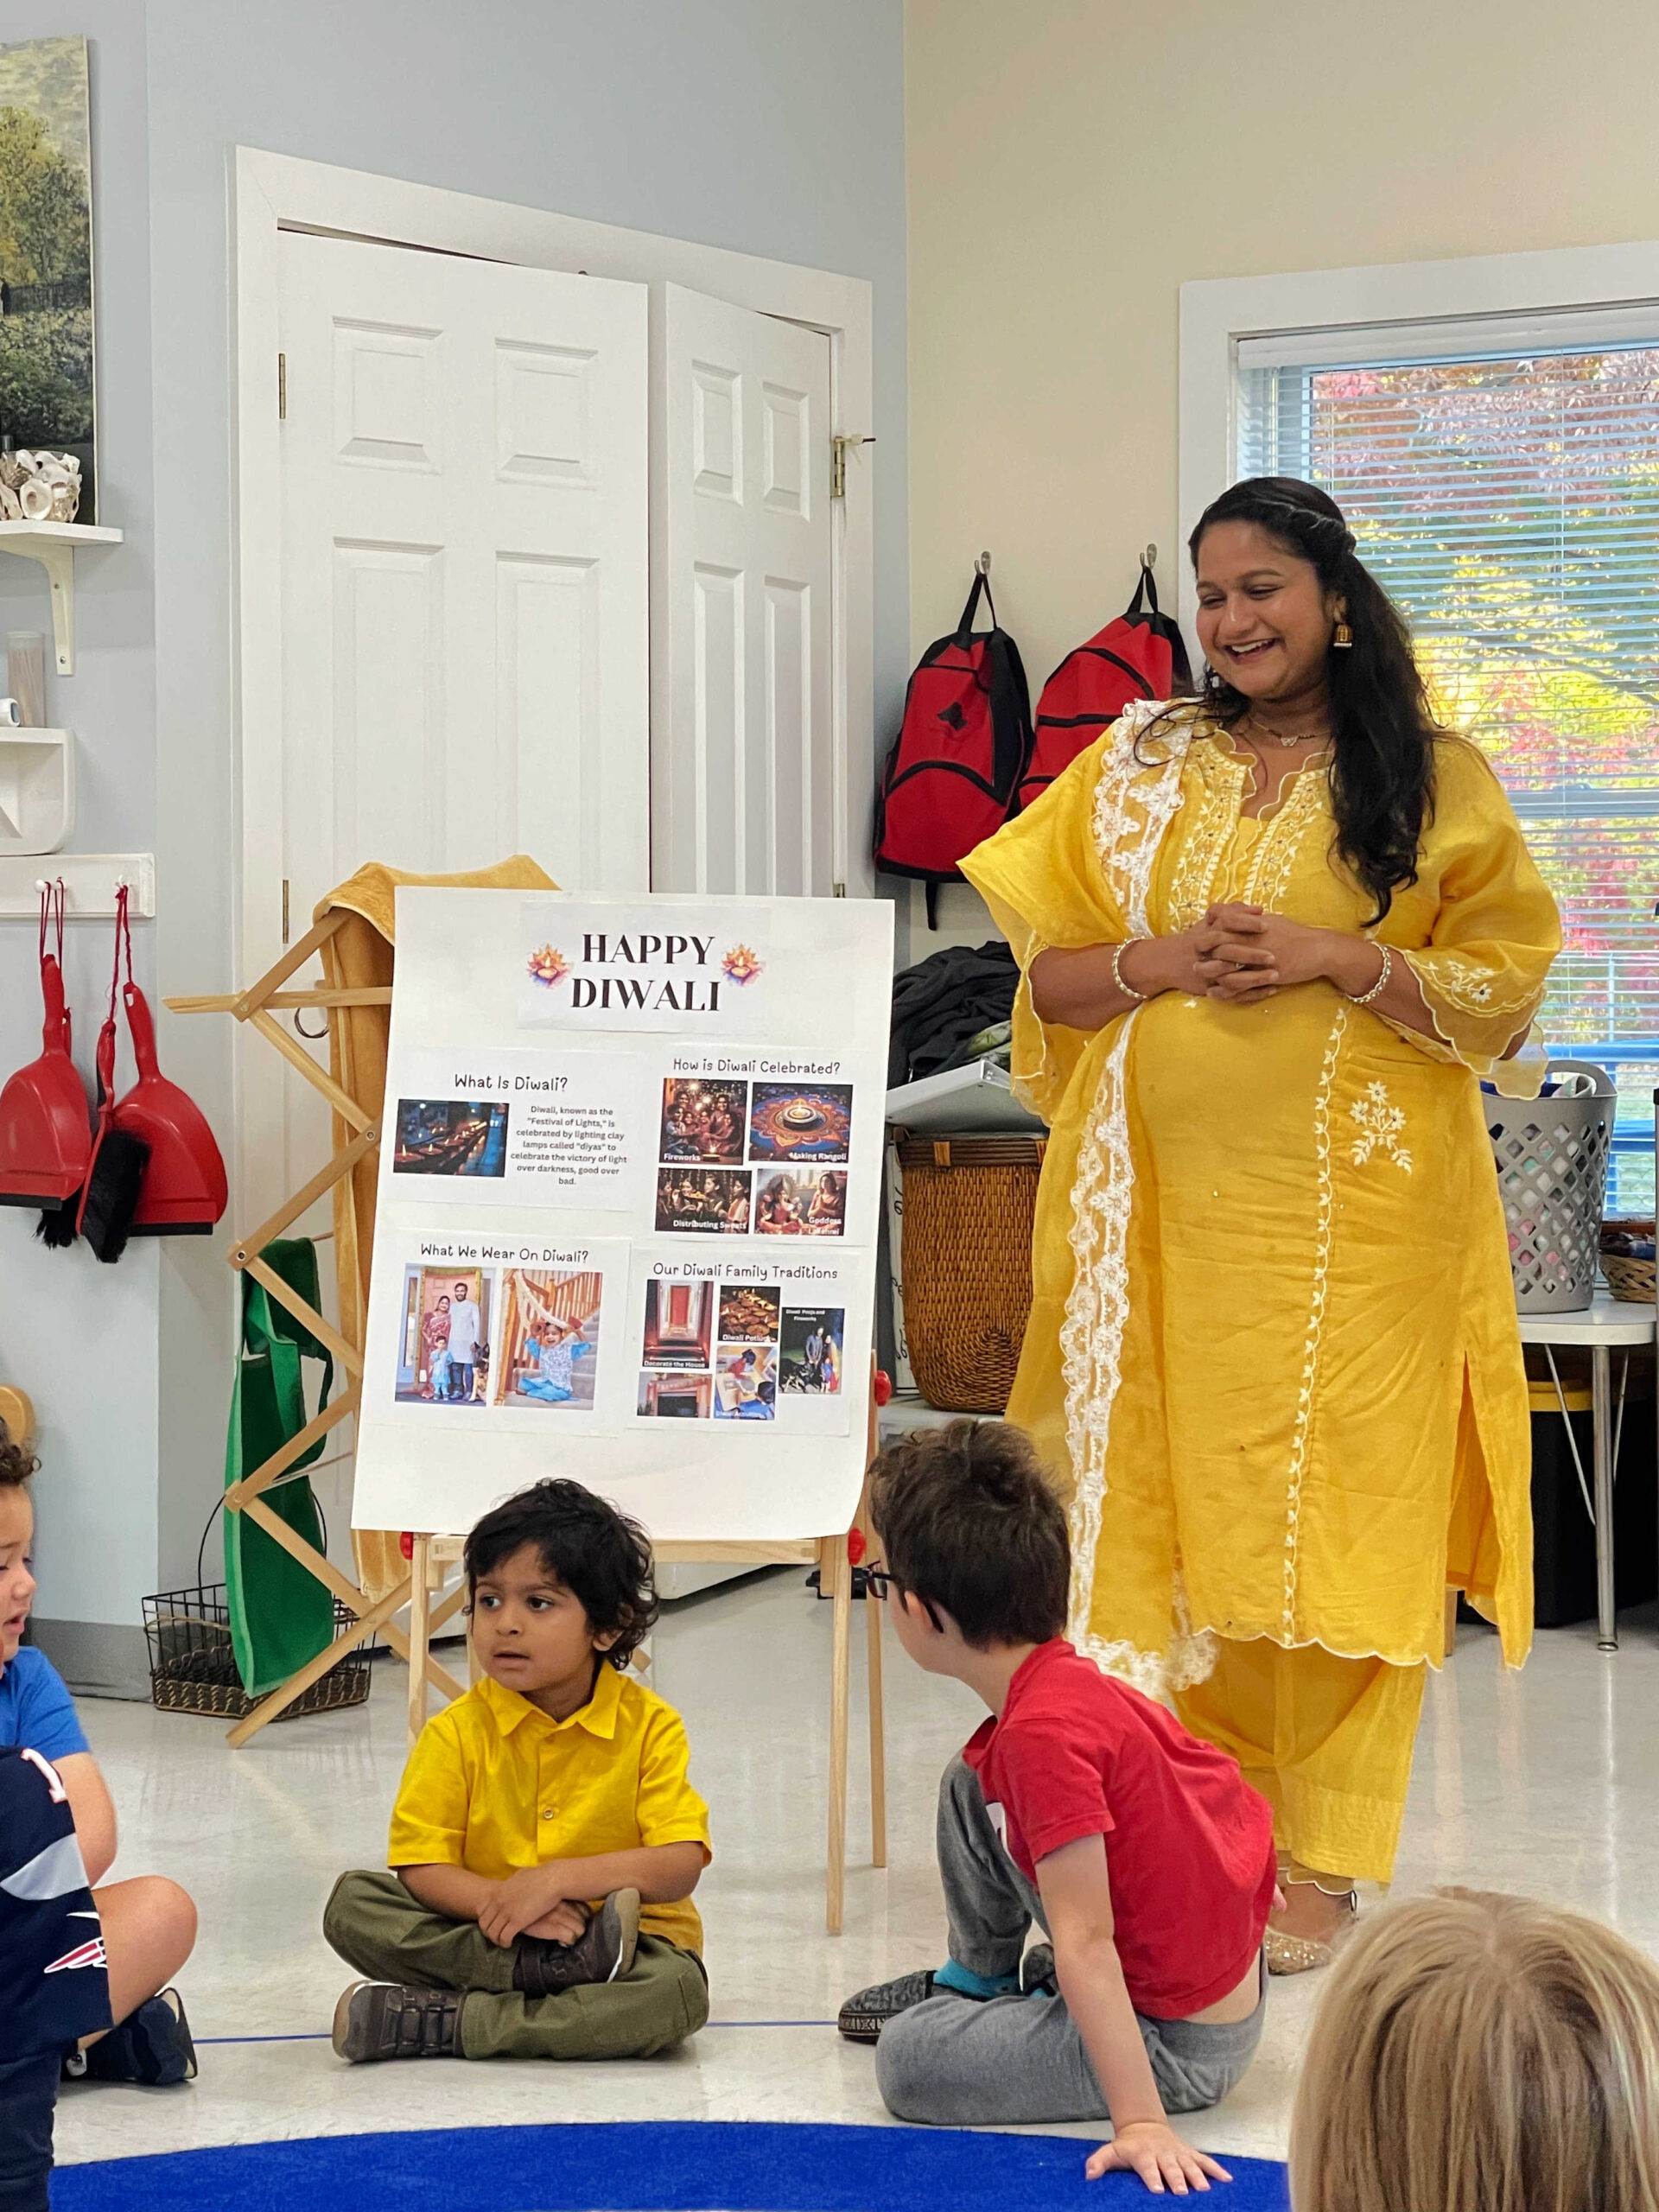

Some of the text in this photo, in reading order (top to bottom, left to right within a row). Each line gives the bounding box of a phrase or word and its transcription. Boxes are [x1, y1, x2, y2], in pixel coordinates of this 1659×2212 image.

[582, 933, 715, 965] HAPPY
[570, 977, 721, 1012] DIWALI
[672, 1058, 841, 1075] How is Diwali Celebrated?
[454, 1073, 568, 1092] What Is Diwali?
[531, 1105, 558, 1115] Diwali,
[527, 1116, 563, 1126] "Festival
[575, 1119, 607, 1128] Lights,"
[563, 1130, 573, 1139] by
[575, 1130, 606, 1141] lighting
[607, 1132, 625, 1141] clay
[523, 1140, 548, 1150] lamps
[576, 1141, 606, 1152] "diyas"
[511, 1152, 550, 1160] celebrate
[551, 1153, 566, 1161] the
[567, 1154, 596, 1164] victory
[608, 1155, 627, 1165] light
[663, 1153, 702, 1162] Fireworks
[818, 1153, 847, 1163] Rangoli
[537, 1164, 576, 1174] darkness,
[578, 1166, 599, 1175] good
[672, 1219, 718, 1230] Distributing
[421, 1243, 588, 1263] What We Wear On Diwali?
[653, 1262, 838, 1281] Our Diwali Family Traditions
